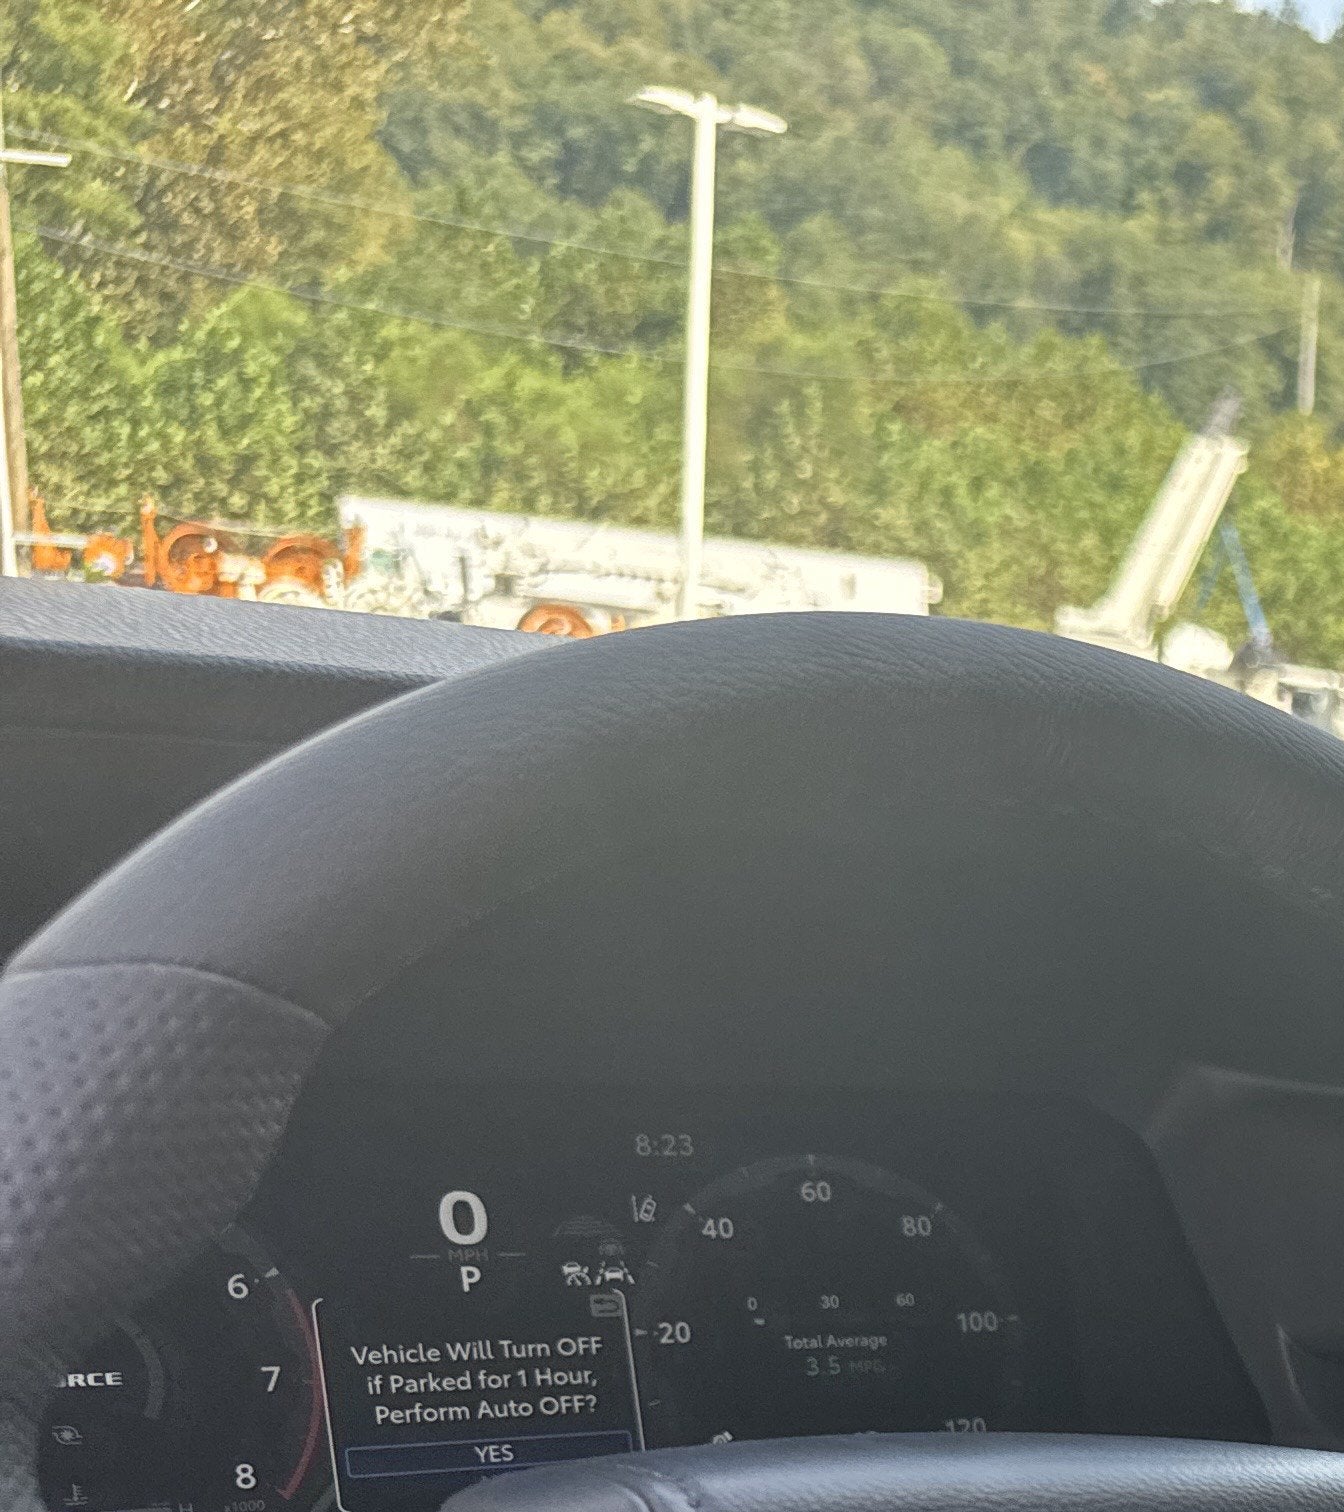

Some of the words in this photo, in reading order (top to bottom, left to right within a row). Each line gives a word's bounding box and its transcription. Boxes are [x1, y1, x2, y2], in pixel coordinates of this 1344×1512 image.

[635, 1133, 694, 1156] 8:23
[801, 1181, 832, 1202] 60
[439, 1190, 488, 1245] 0
[701, 1217, 734, 1239] 40
[902, 1215, 932, 1237] 80
[227, 1274, 249, 1300] 6
[461, 1265, 482, 1293] P
[821, 1295, 840, 1310] 30
[896, 1293, 915, 1307] 60
[658, 1322, 691, 1344] 20
[957, 1311, 998, 1333] 100
[351, 1343, 441, 1366] Vehicle
[446, 1340, 495, 1361] Will
[499, 1340, 551, 1359] Turn
[557, 1337, 602, 1356] OFF
[785, 1335, 823, 1350] Total
[828, 1333, 888, 1351] Average
[261, 1365, 281, 1392] 7
[367, 1375, 384, 1395] if
[390, 1371, 472, 1394] Parked
[478, 1370, 511, 1389] for
[517, 1370, 527, 1387] 1
[535, 1367, 598, 1388] Hour,
[375, 1405, 470, 1425] Perform
[477, 1401, 533, 1419] Auto
[539, 1395, 597, 1416] OFF?
[474, 1445, 515, 1463] YES
[235, 1463, 257, 1489] 8
